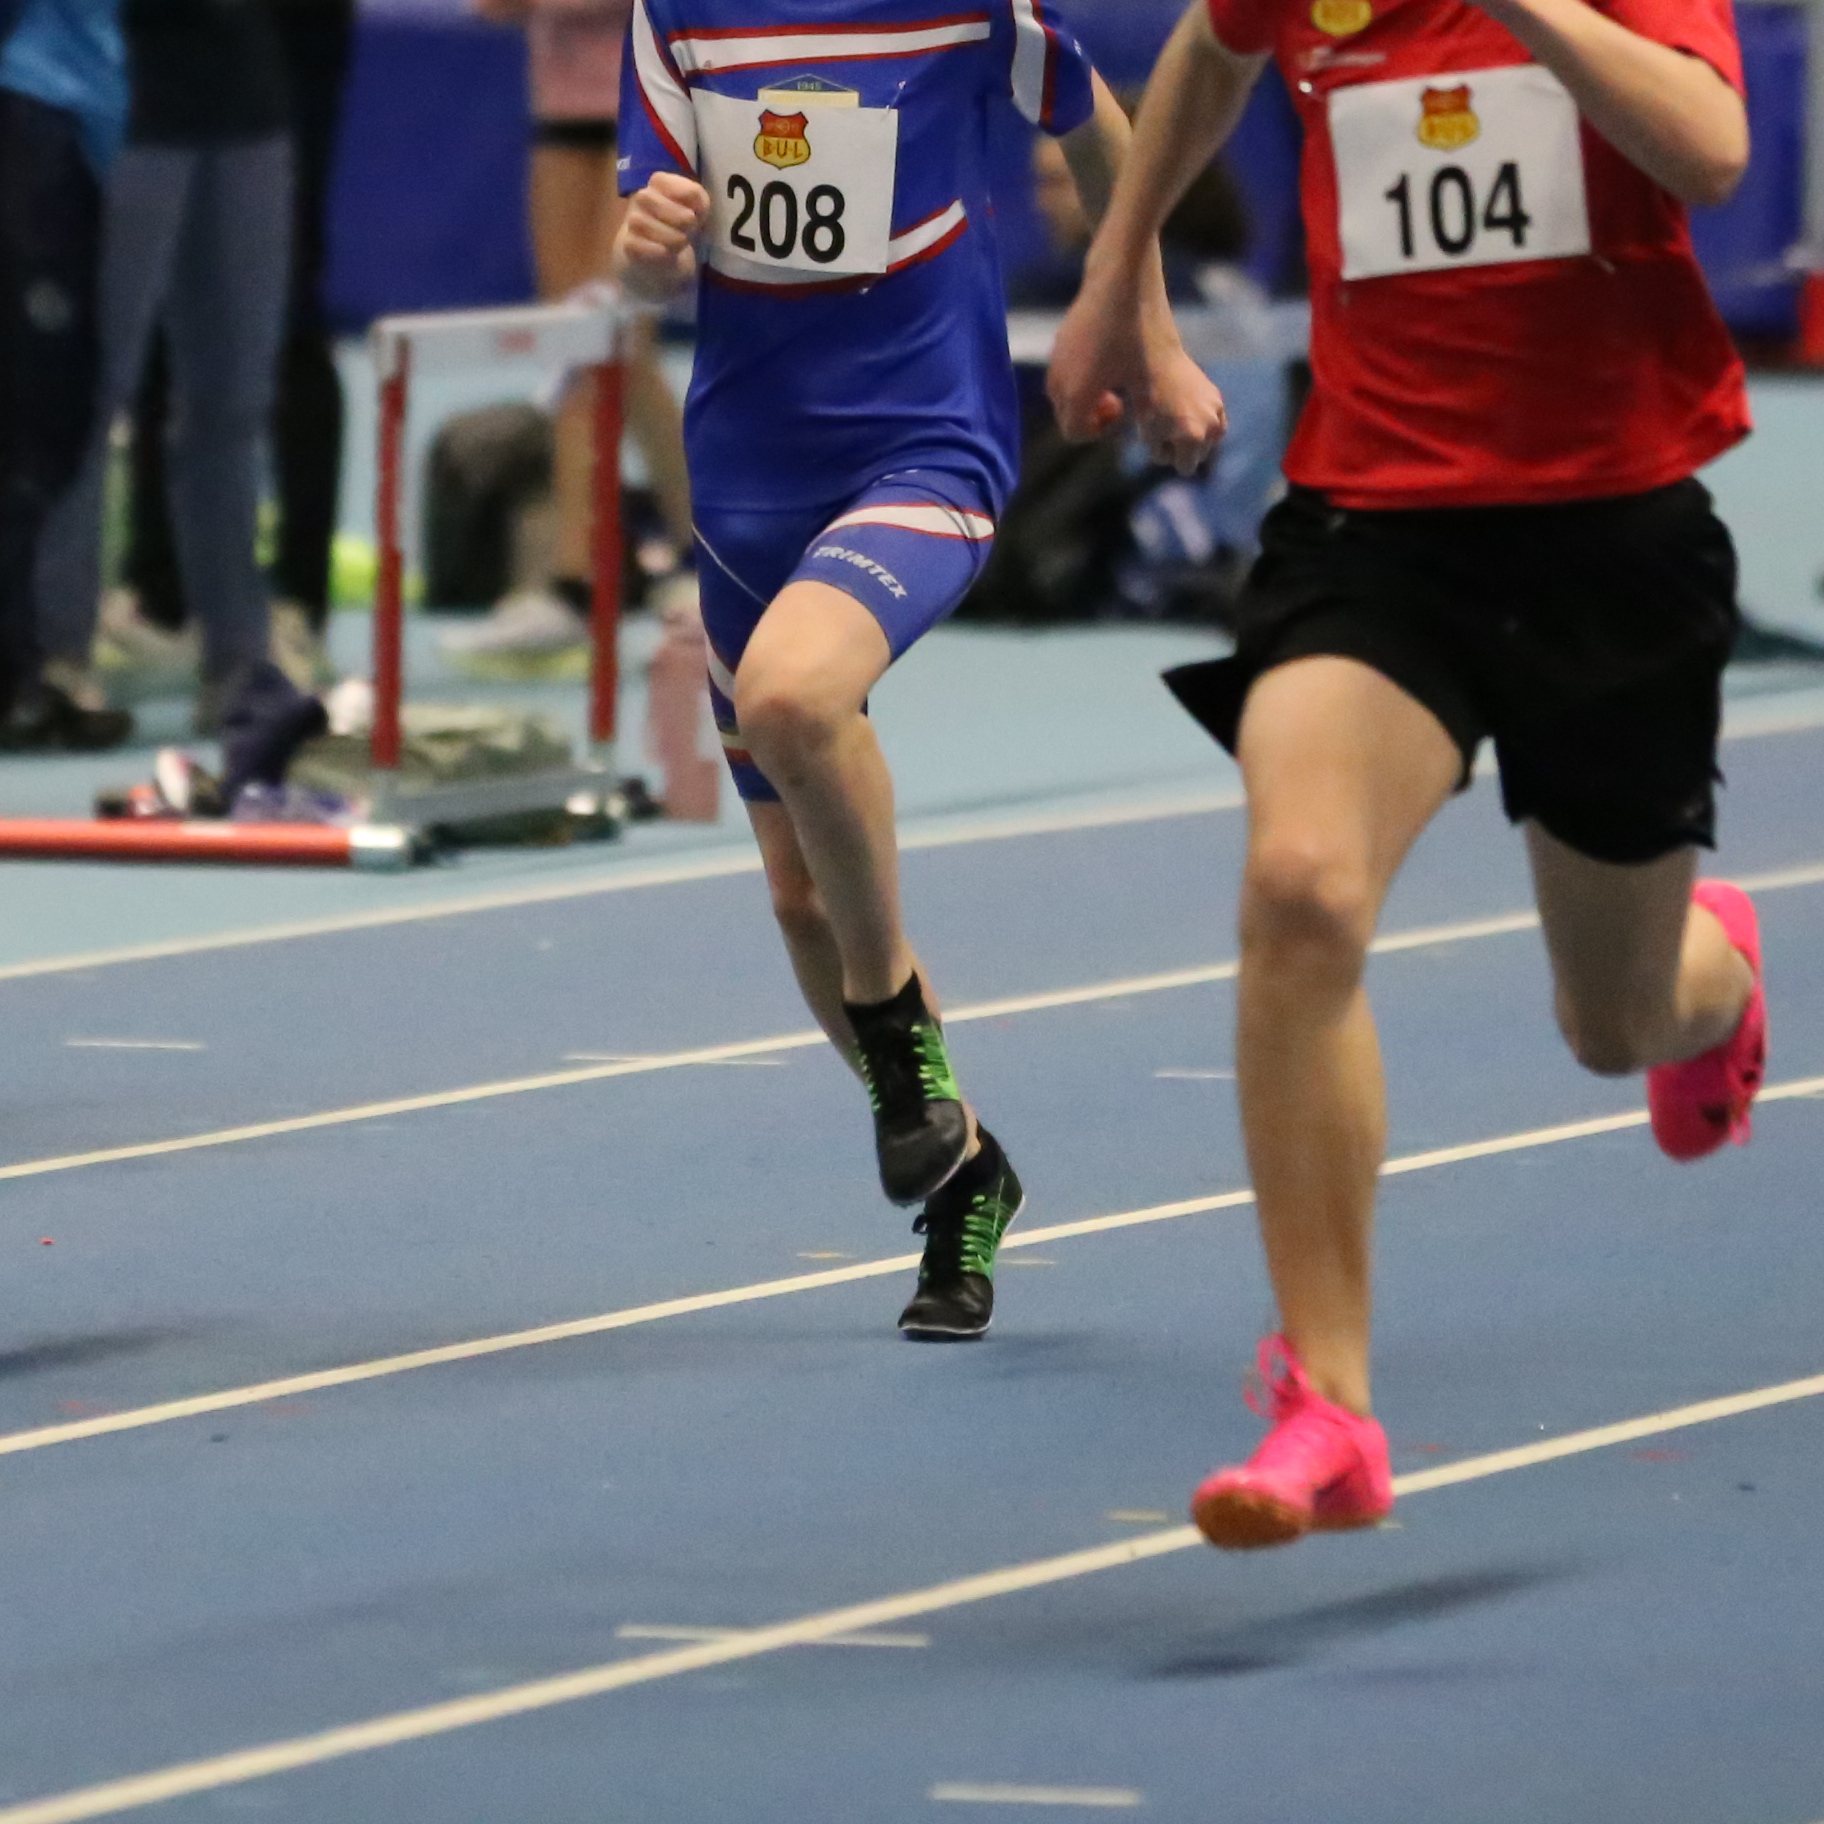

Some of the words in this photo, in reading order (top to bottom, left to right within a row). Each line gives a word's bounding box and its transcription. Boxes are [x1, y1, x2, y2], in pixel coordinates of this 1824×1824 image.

[727, 173, 845, 264] 208
[1384, 160, 1530, 260] 104
[812, 546, 907, 599] TRIMTEX
